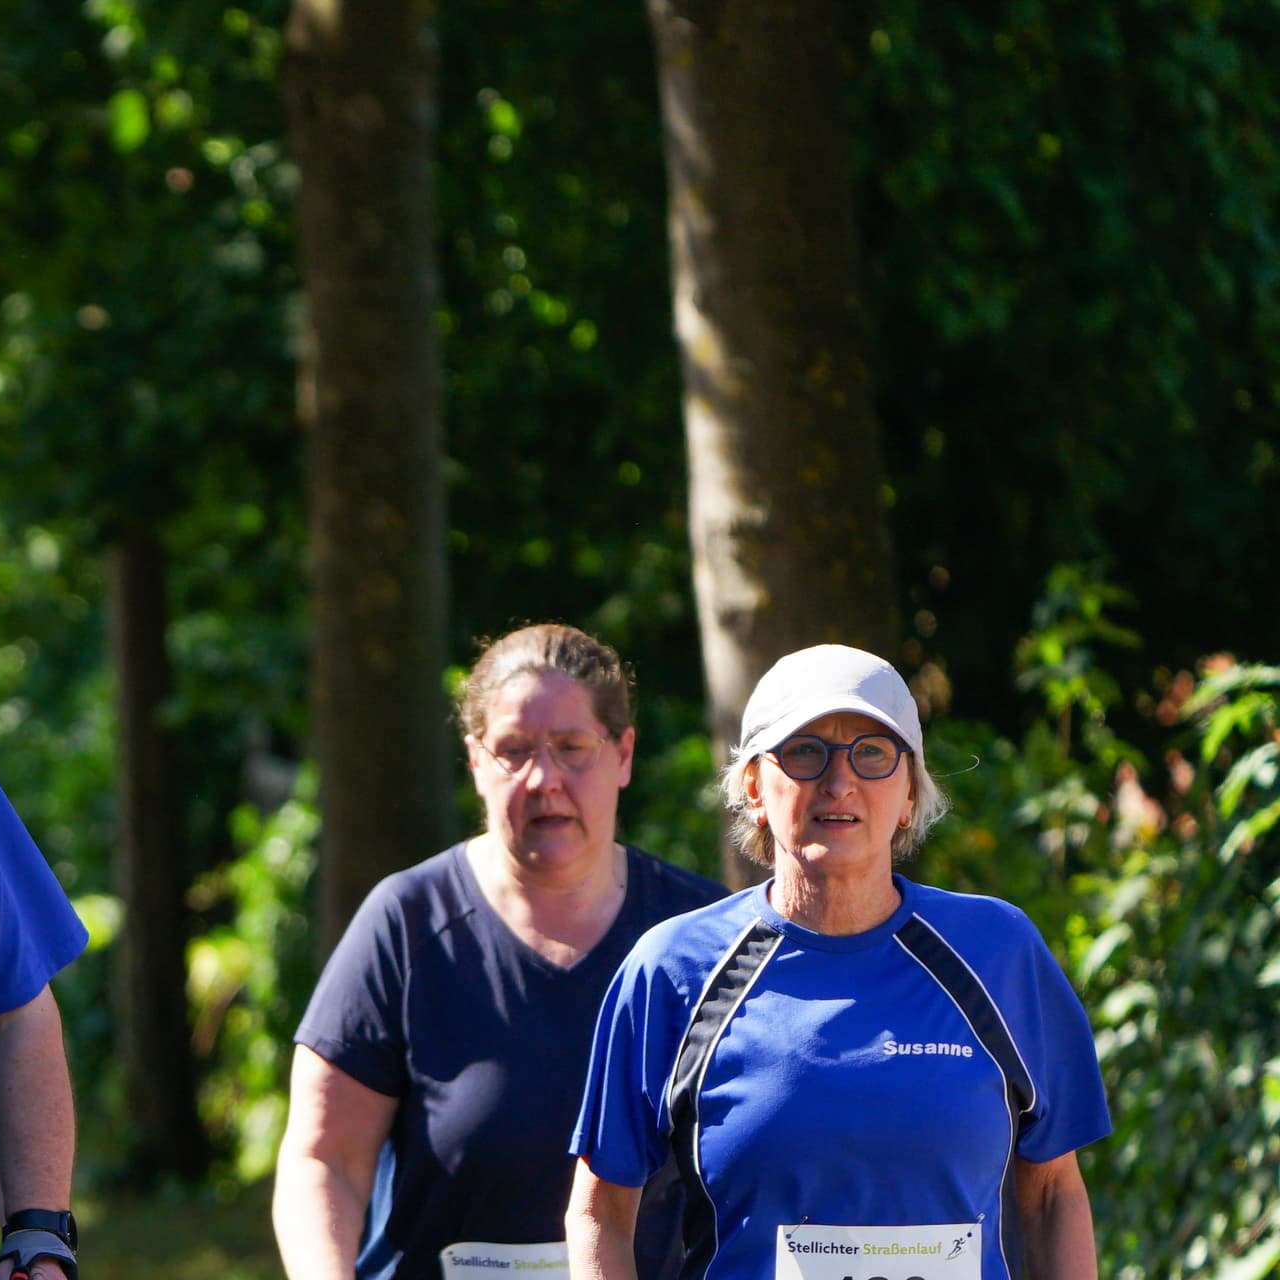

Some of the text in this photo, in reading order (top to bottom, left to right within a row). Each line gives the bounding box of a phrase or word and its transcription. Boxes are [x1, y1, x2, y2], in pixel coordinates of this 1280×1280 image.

[882, 1040, 974, 1058] Susanne
[787, 1241, 943, 1256] Stellichter Straßenlauf
[451, 1256, 510, 1269] Stellichter
